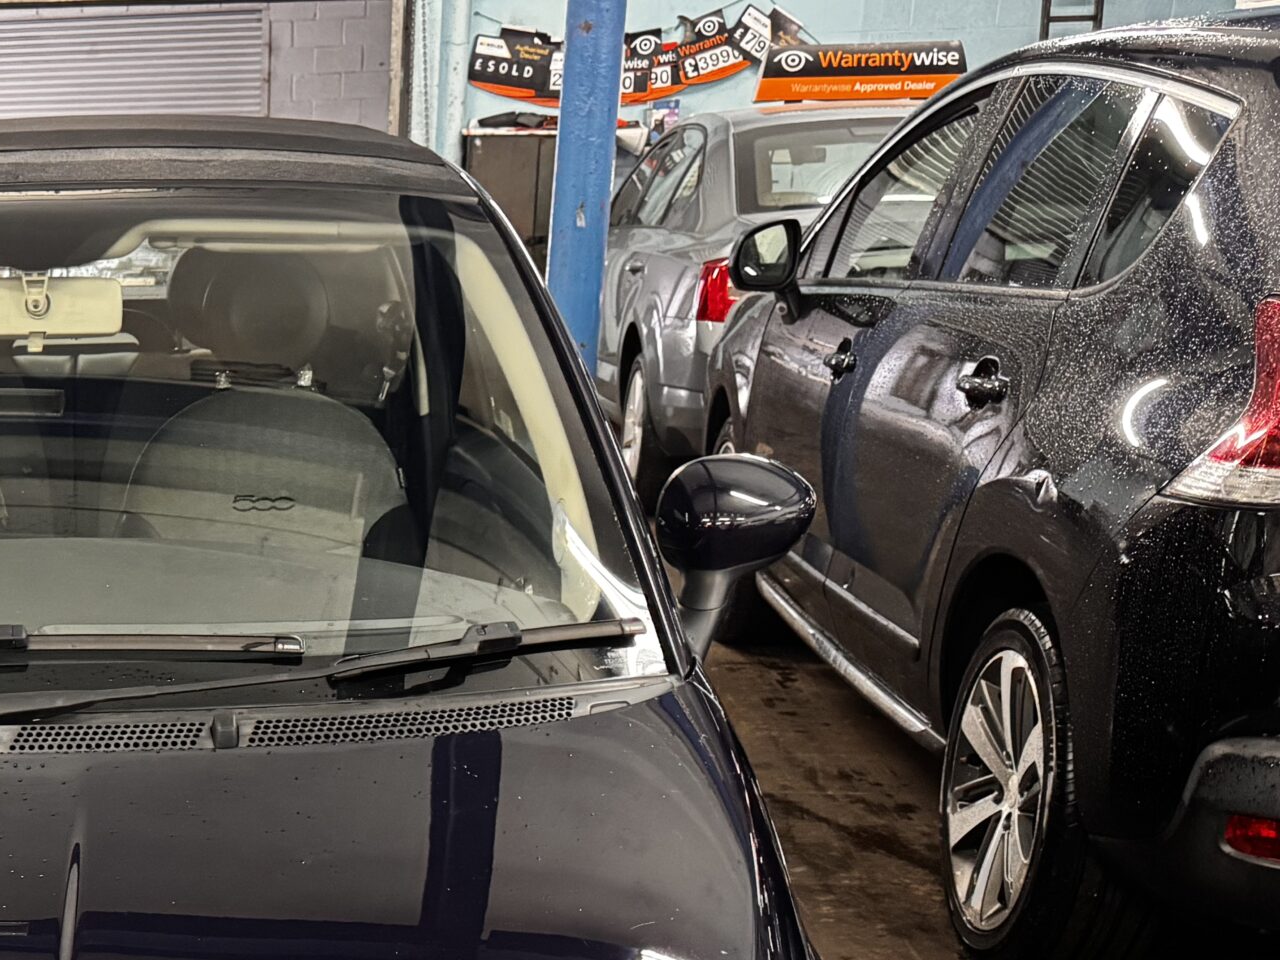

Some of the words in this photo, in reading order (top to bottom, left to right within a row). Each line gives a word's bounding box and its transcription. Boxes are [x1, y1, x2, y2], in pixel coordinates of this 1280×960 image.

[678, 33, 729, 56] Warranty
[819, 48, 959, 71] Warrantywise
[853, 81, 902, 93] Approved
[904, 80, 936, 91] Dealer
